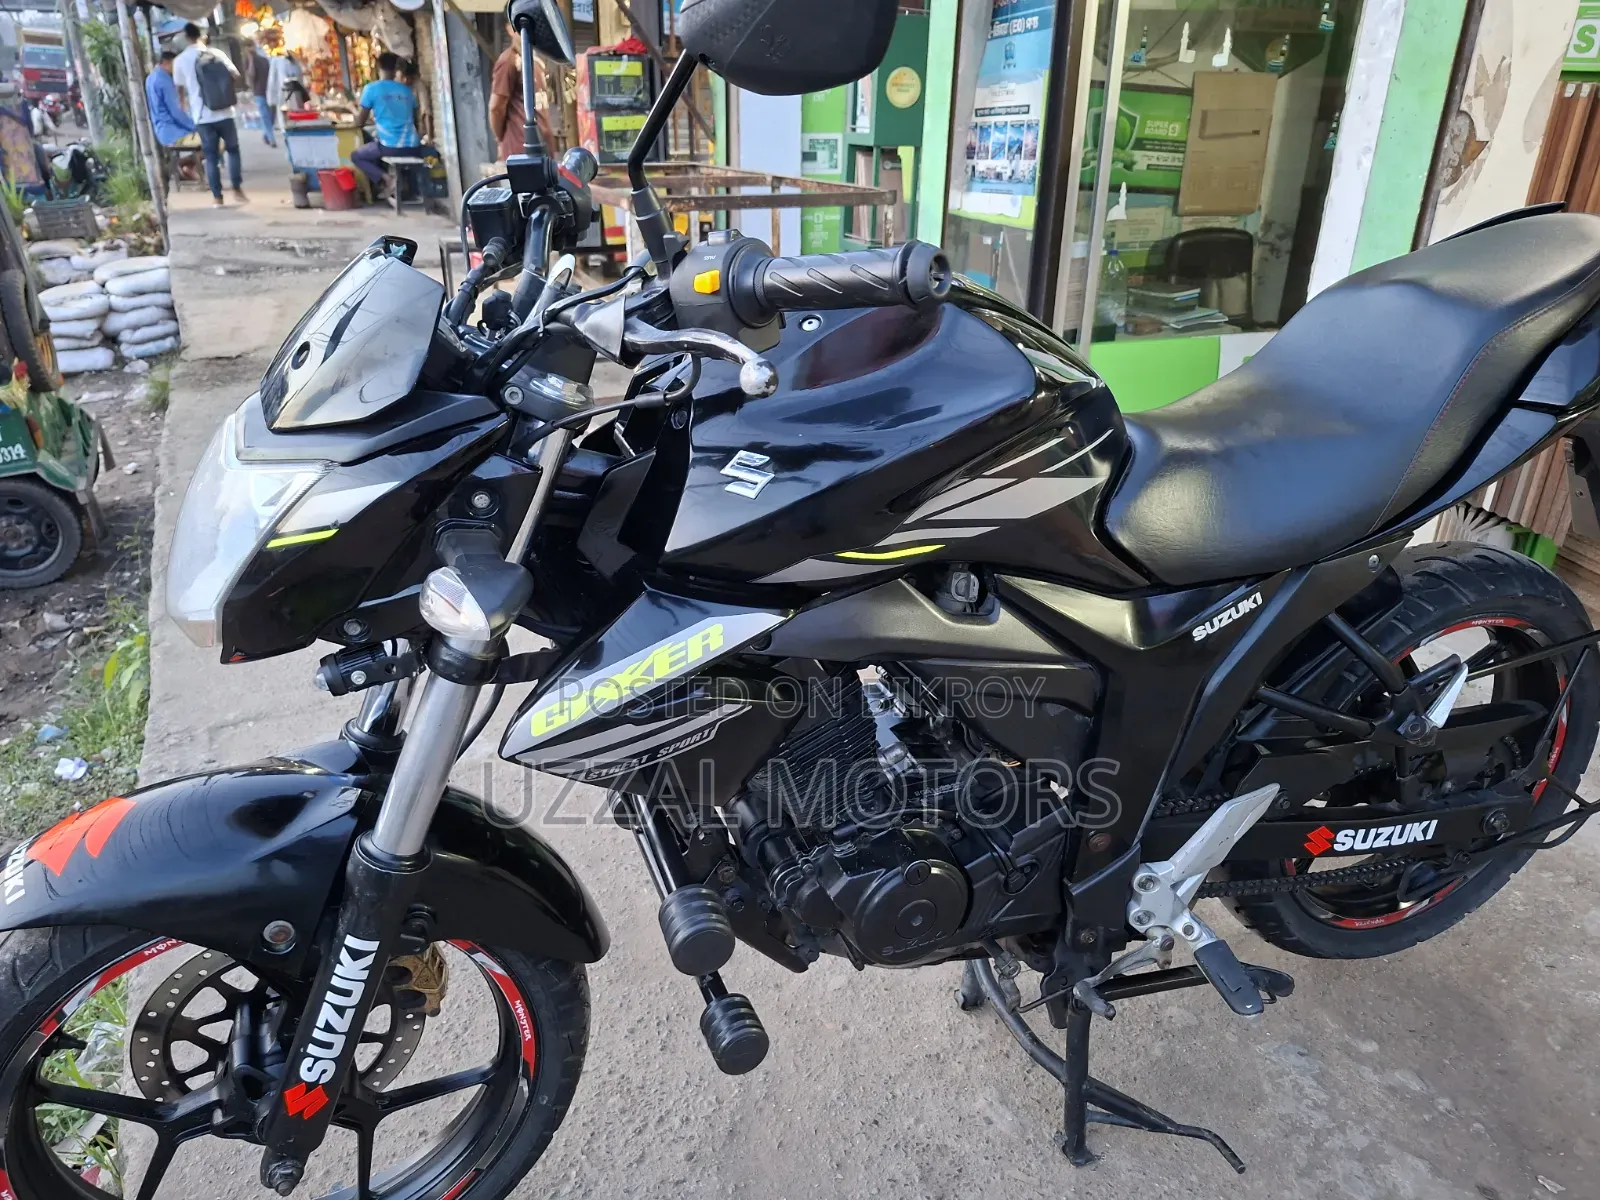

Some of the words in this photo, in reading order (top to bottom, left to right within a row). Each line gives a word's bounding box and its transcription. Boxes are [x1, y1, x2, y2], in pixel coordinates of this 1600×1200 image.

[1192, 591, 1263, 641] SUZUKI
[530, 623, 724, 737] GIXXER
[587, 754, 651, 781] STREET
[656, 726, 715, 758] SPORT
[1333, 819, 1438, 852] SUZUKI
[300, 934, 380, 1084] SUZUKI
[514, 999, 532, 1042] MONSTER
